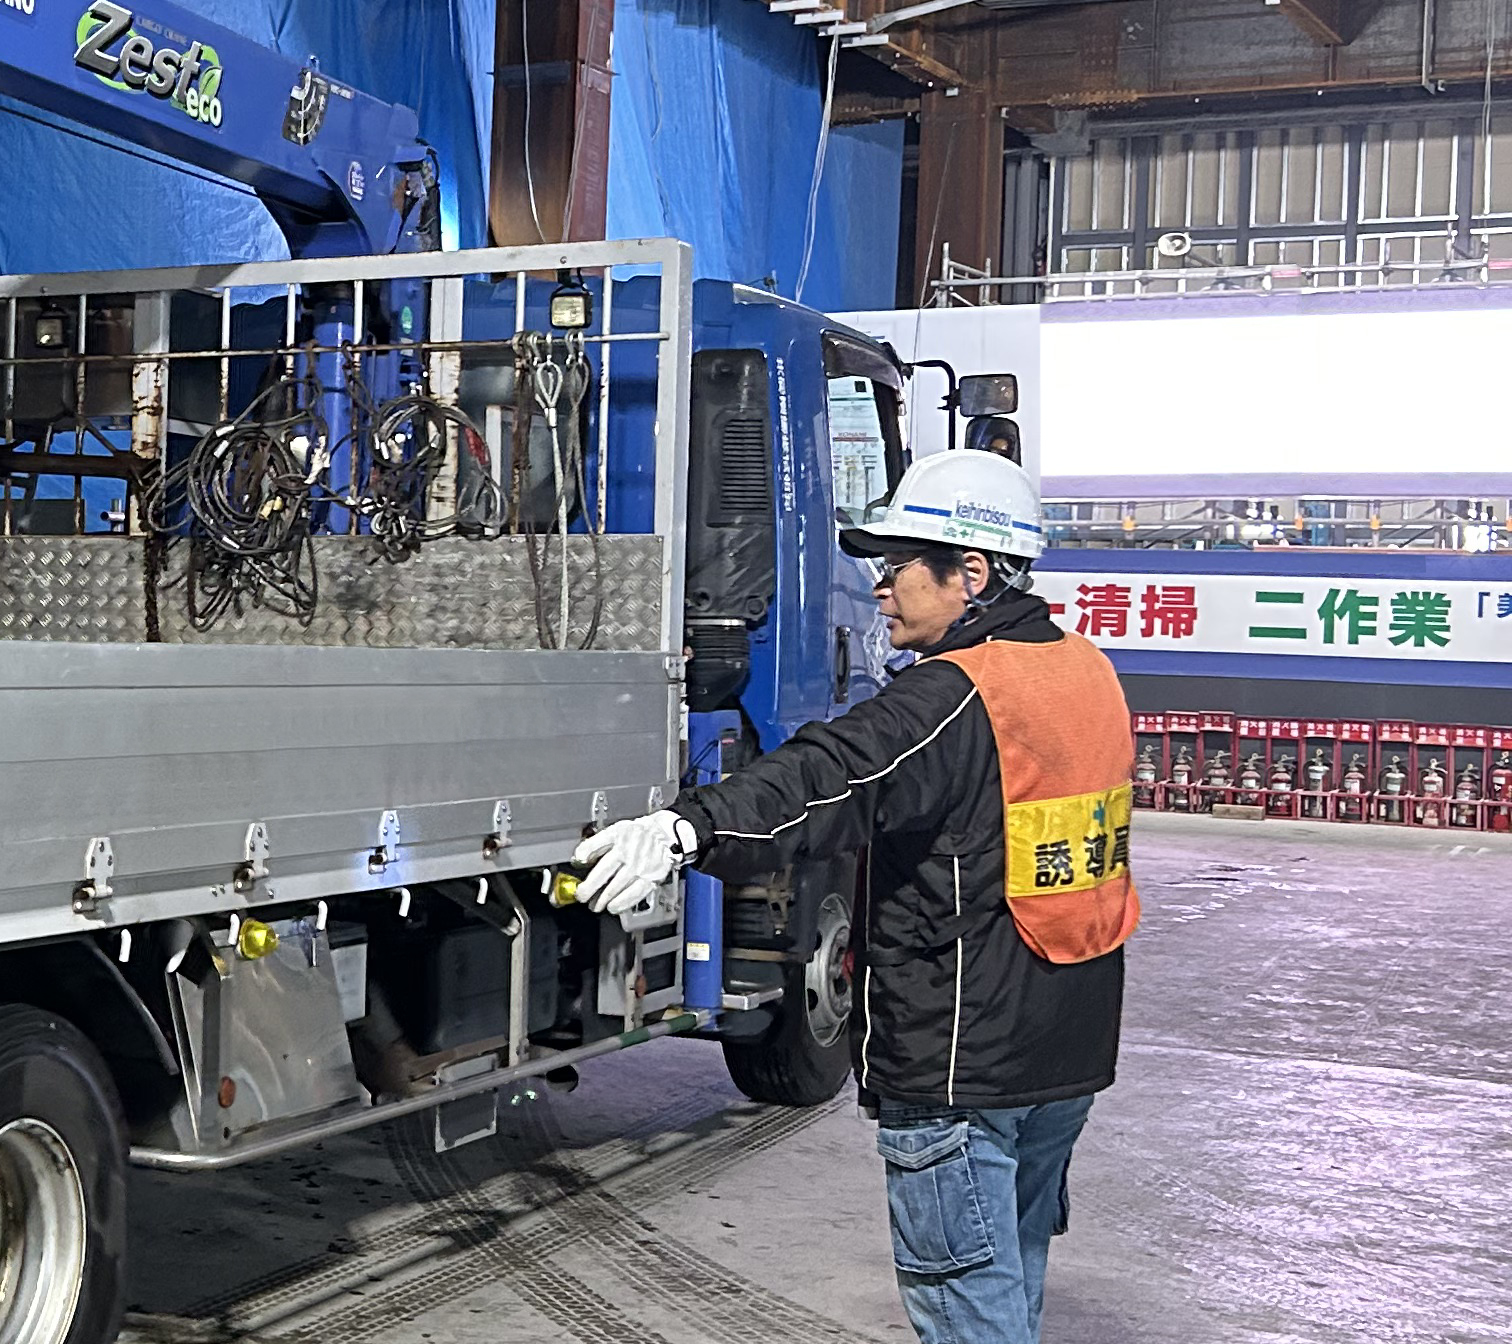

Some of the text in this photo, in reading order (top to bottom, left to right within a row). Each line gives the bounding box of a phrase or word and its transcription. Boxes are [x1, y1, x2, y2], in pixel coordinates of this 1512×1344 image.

[186, 87, 222, 127] eco
[1049, 583, 1198, 639] 清掃
[1249, 588, 1452, 648] 二作業
